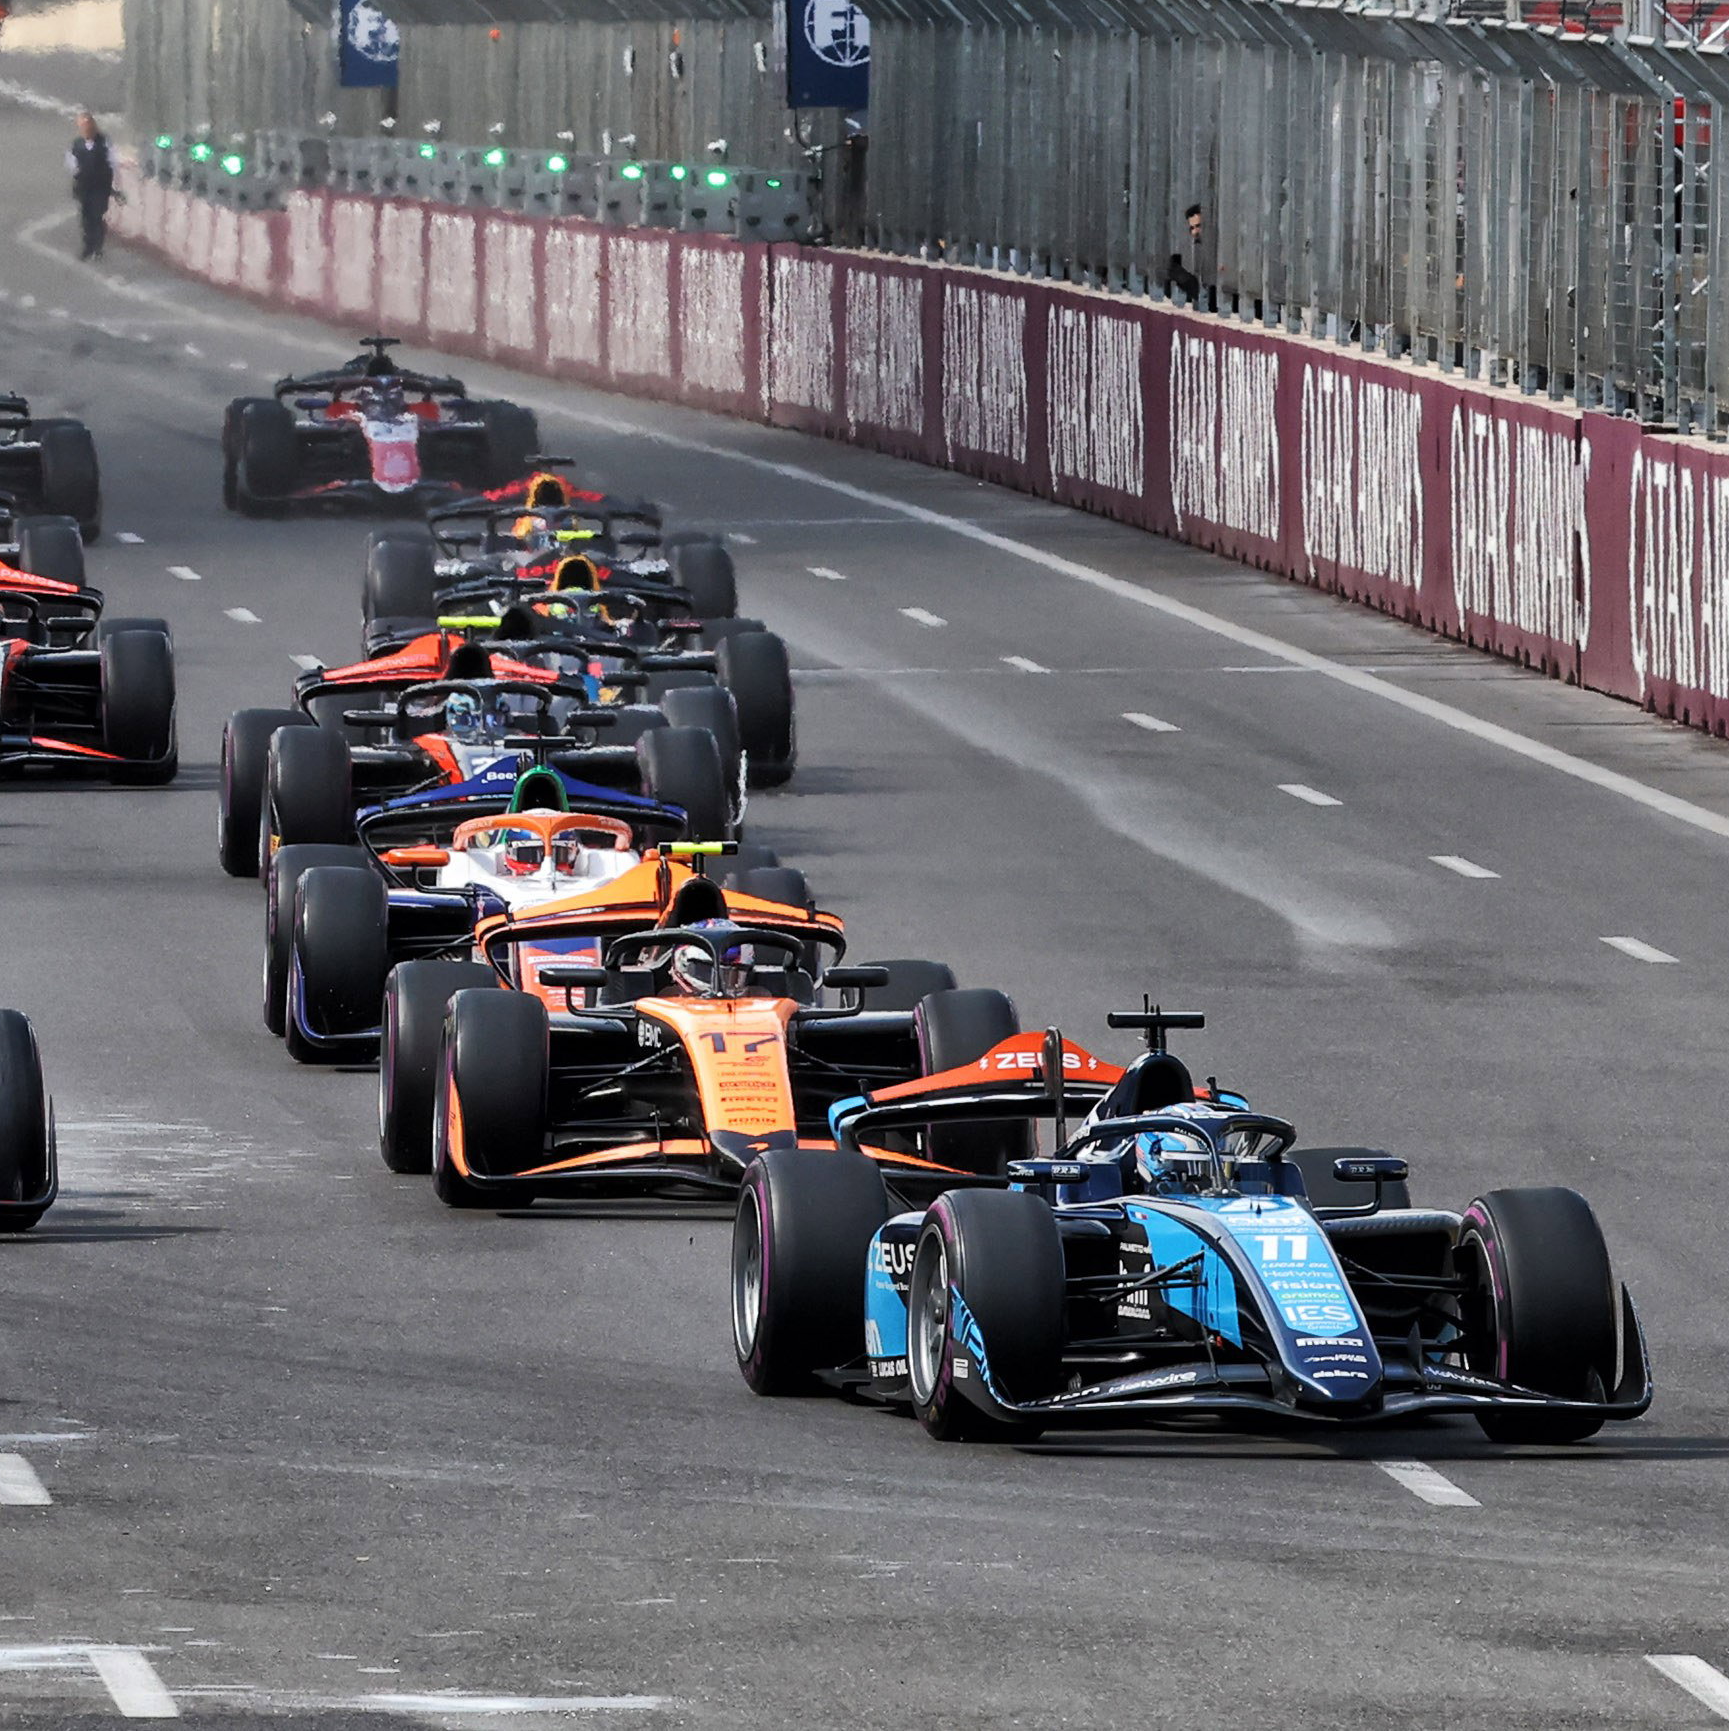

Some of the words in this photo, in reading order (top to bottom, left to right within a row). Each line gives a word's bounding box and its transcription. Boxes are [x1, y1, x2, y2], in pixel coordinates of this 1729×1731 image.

[698, 1031, 780, 1054] 17
[994, 1051, 1083, 1070] ZES
[873, 1241, 918, 1275] ZEUS
[1254, 1235, 1309, 1261] 11
[1270, 1279, 1342, 1291] fision
[1284, 1305, 1352, 1322] IES
[878, 1360, 895, 1378] LUCAS
[895, 1358, 909, 1376] OIL
